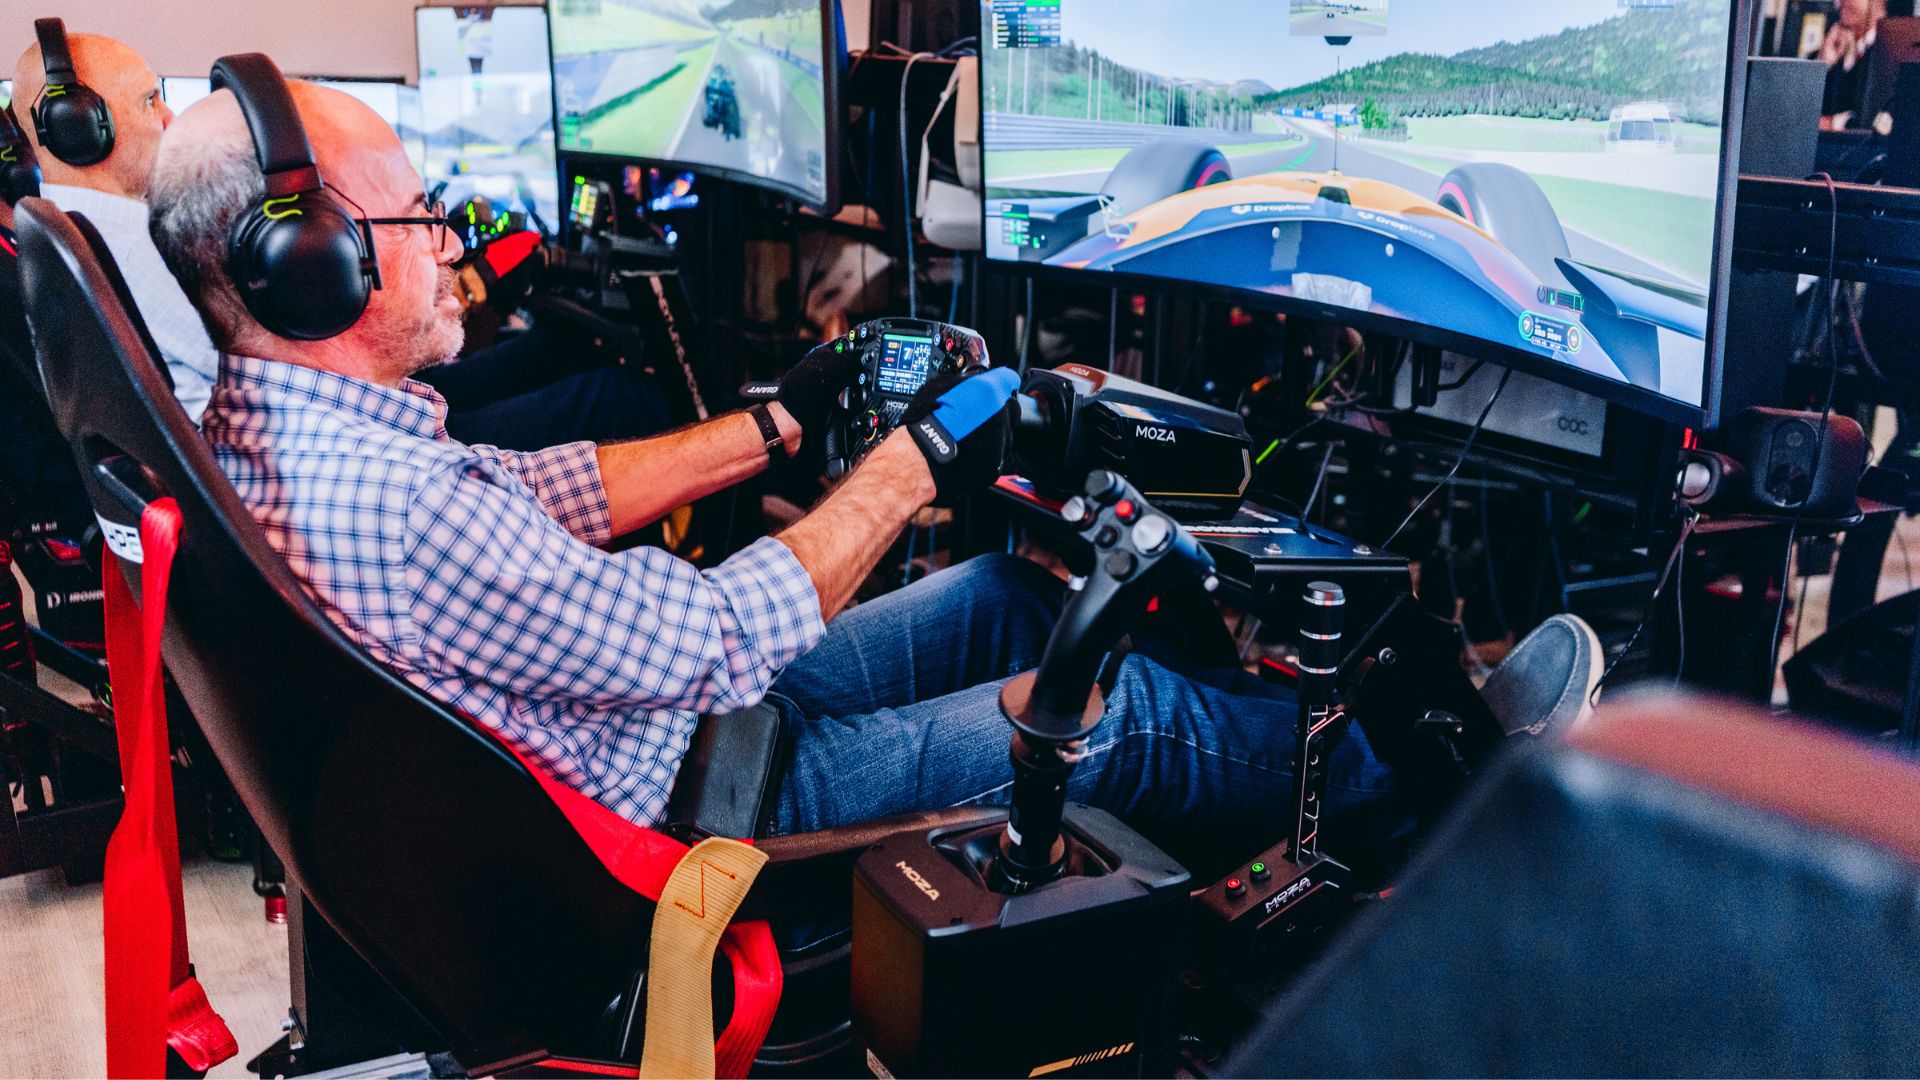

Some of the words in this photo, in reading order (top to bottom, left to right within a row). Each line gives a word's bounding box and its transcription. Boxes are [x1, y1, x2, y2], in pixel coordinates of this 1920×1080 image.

[1253, 204, 1311, 213] Dropbox
[1375, 215, 1436, 240] Dropbox
[747, 386, 779, 394] GIANT
[886, 401, 909, 409] MOZA
[920, 423, 950, 454] GIANT
[1135, 424, 1176, 443] MOZA
[896, 861, 939, 901] MOZA
[1265, 877, 1310, 909] MOZA
